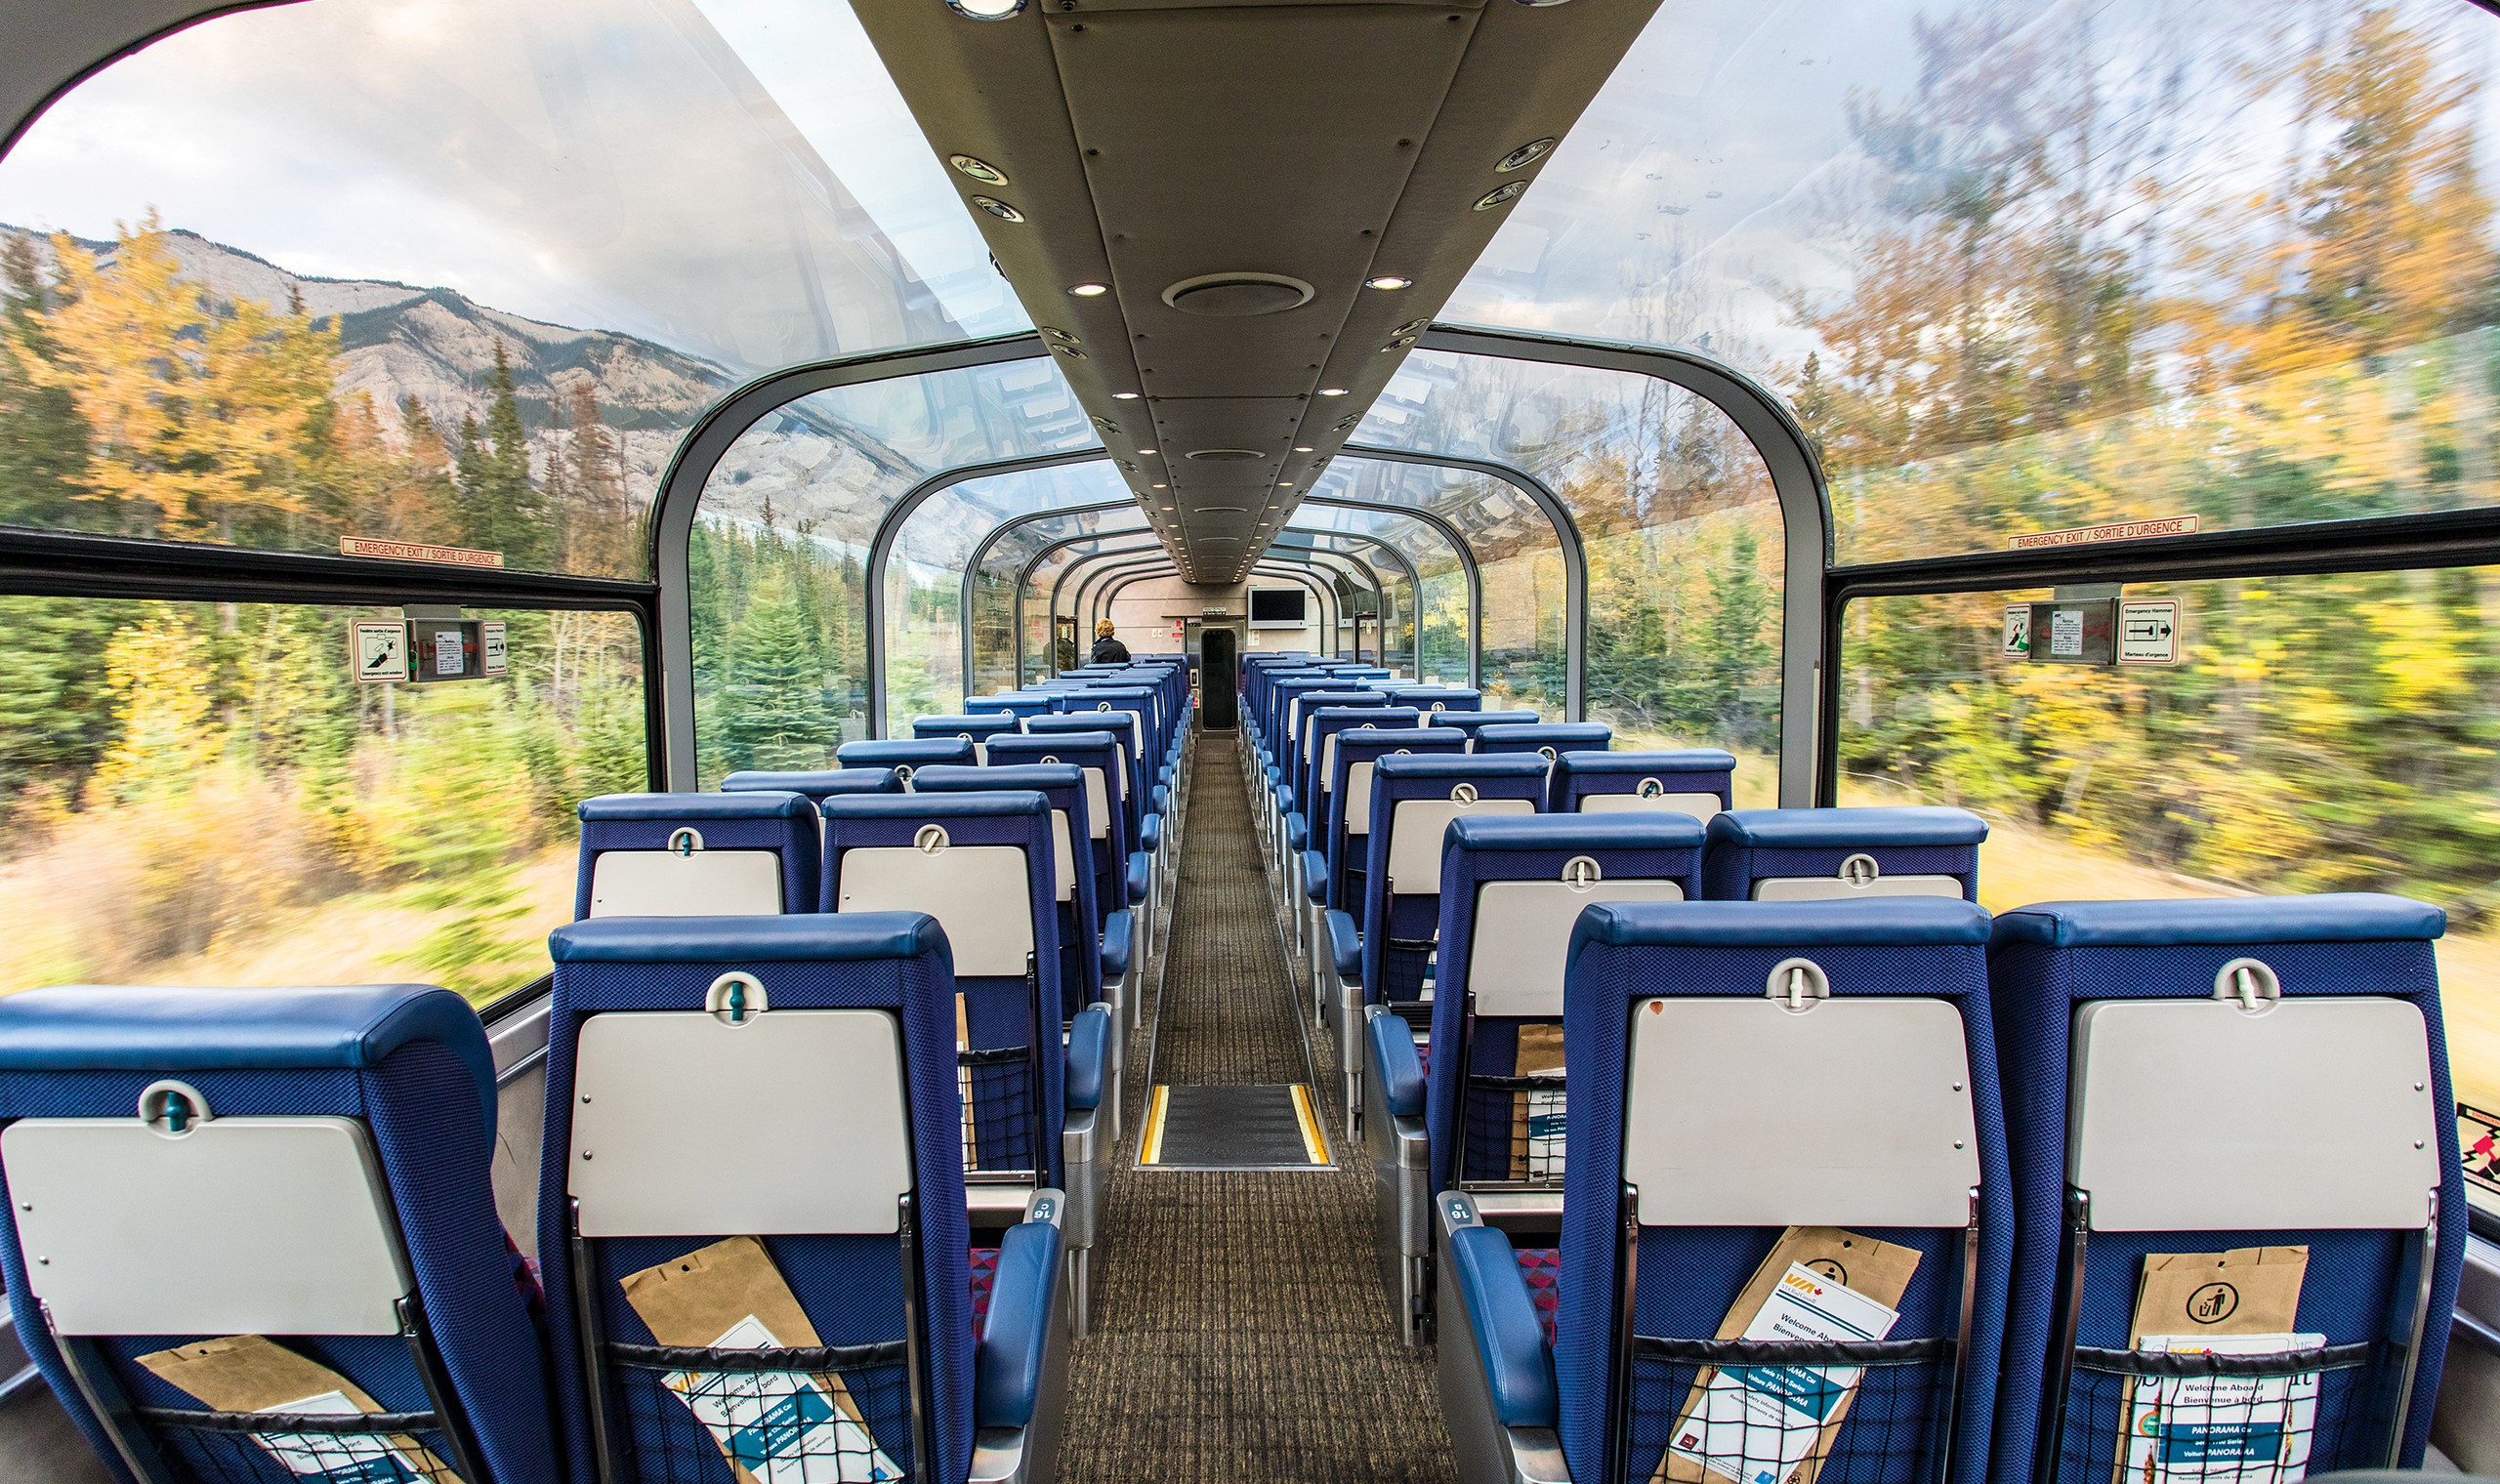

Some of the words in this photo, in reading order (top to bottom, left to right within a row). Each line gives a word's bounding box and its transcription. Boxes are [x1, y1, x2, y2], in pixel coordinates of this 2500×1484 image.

[2018, 534, 2064, 548] EMERGENCY
[2066, 532, 2084, 543] EXIT
[2087, 530, 2092, 541] /
[2093, 527, 2124, 540] SORTIE
[2127, 521, 2183, 536] D'URGENCE
[354, 541, 405, 556] EMERGENCY
[407, 547, 423, 558] EXIT
[432, 549, 456, 561] SORTIE
[458, 553, 495, 564] D'URGENCE
[1034, 1211, 1051, 1219] 16
[1451, 1211, 1470, 1219] 16
[1785, 1272, 1816, 1295] VIA
[1780, 1313, 1816, 1336] Welcome
[761, 1374, 778, 1389] bord
[1746, 1372, 1766, 1386] Voiture
[1787, 1380, 1806, 1392] Series
[1805, 1375, 1816, 1384] Car
[782, 1402, 793, 1412] Car
